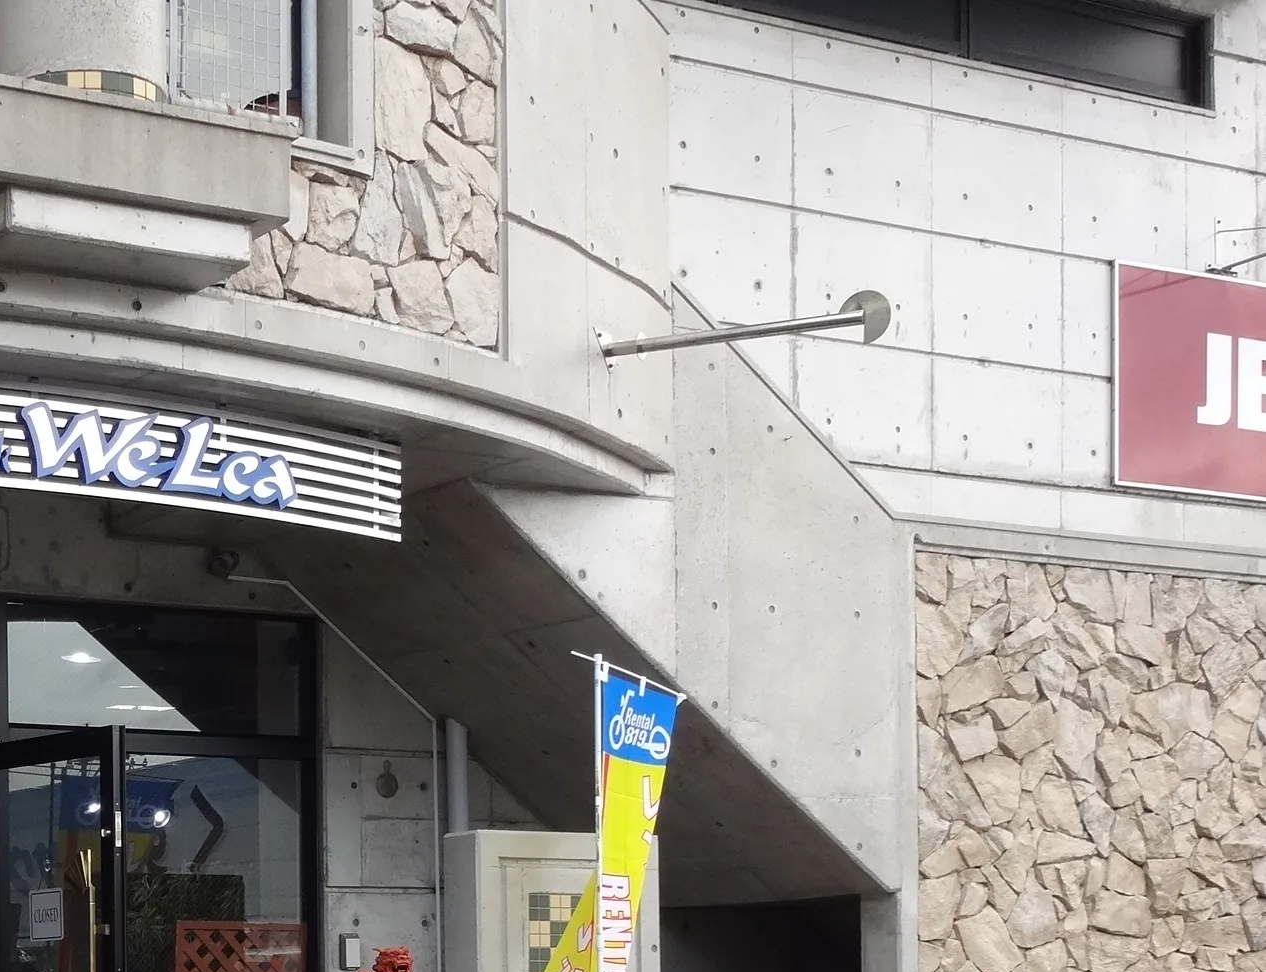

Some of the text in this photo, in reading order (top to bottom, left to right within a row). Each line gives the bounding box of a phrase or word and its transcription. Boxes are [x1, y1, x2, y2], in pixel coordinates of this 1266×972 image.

[625, 706, 656, 731] Rental
[624, 726, 648, 748] 819
[34, 907, 59, 924] CLOSED
